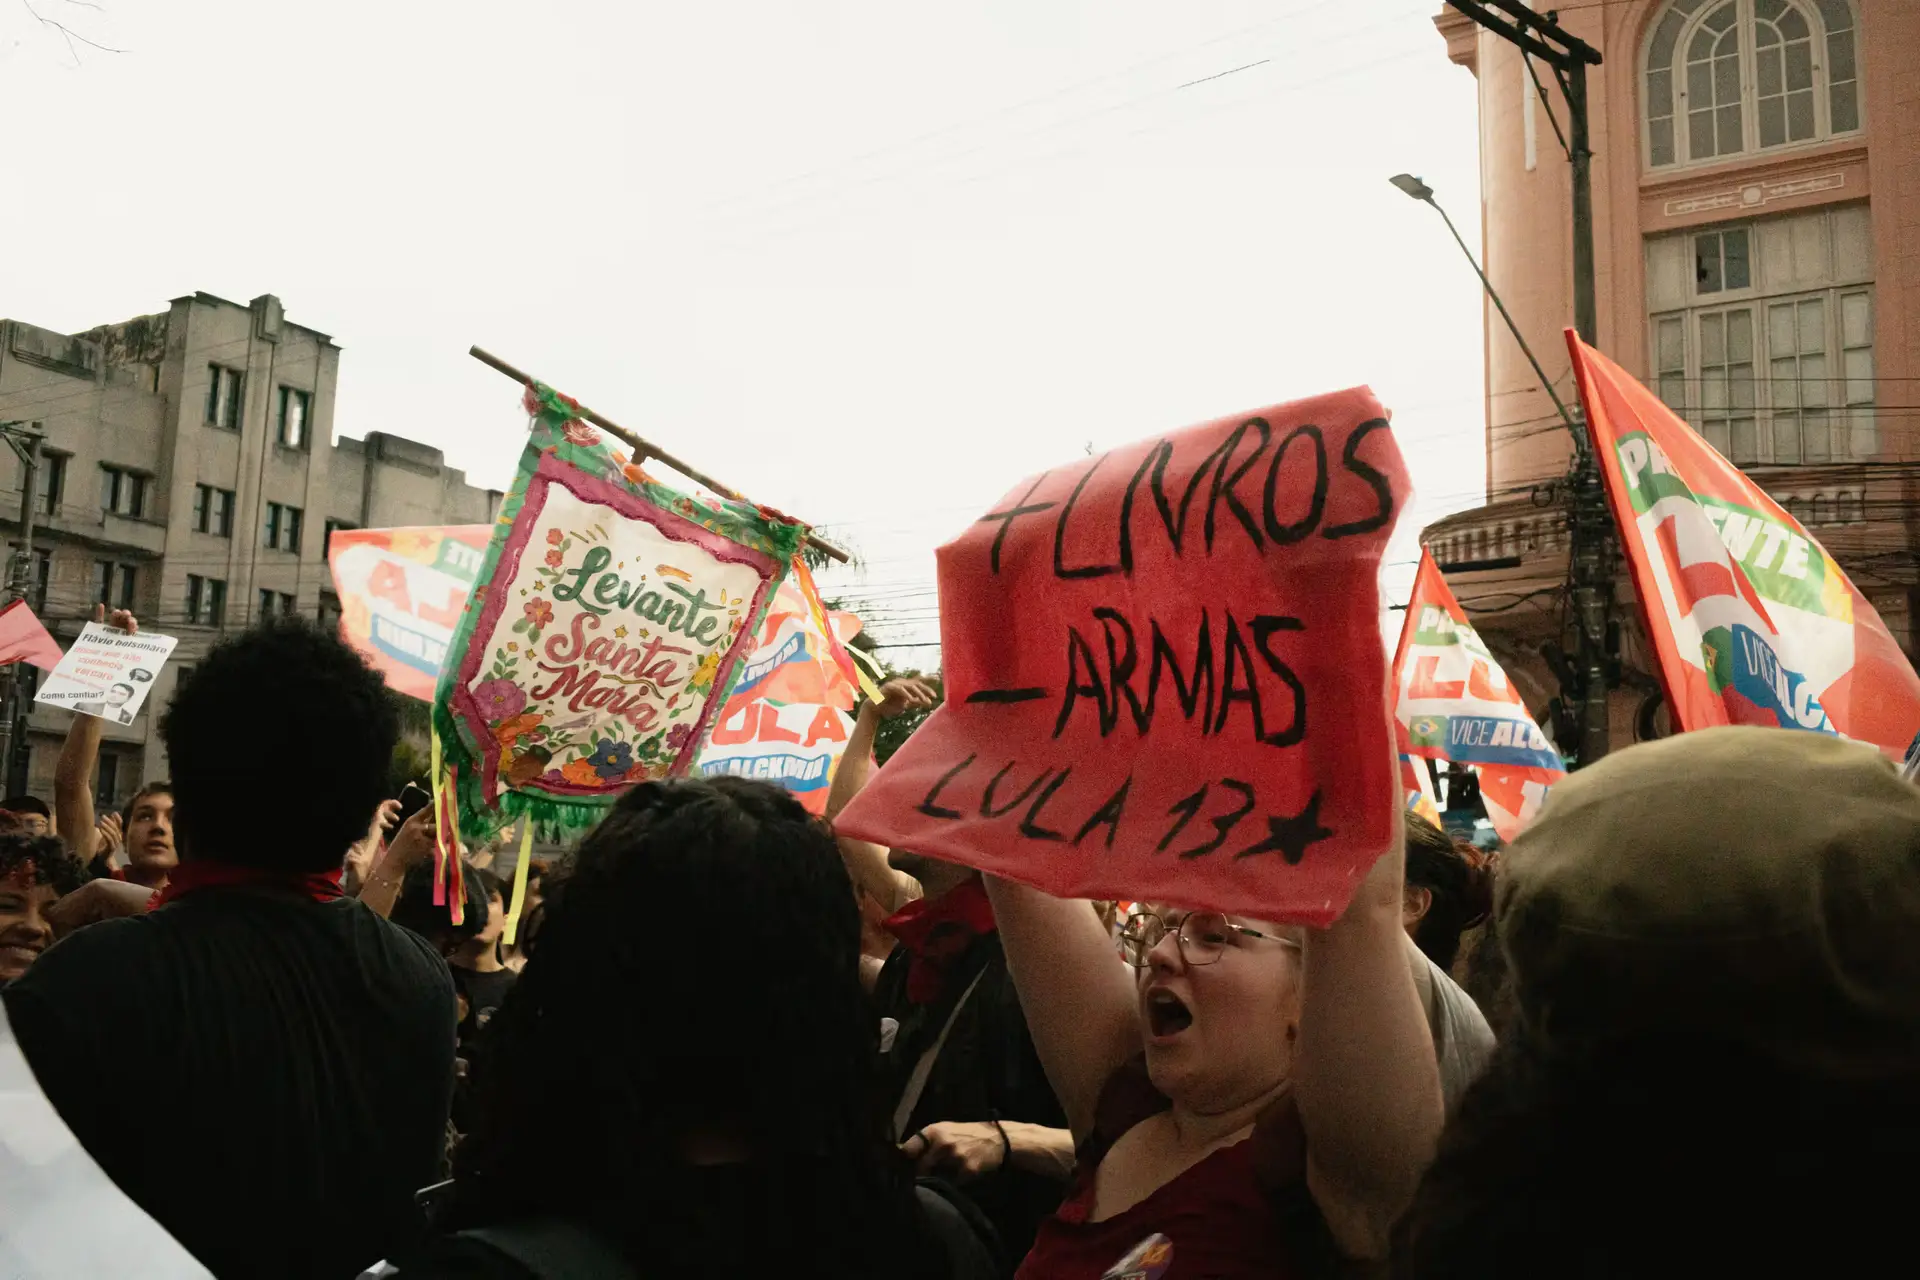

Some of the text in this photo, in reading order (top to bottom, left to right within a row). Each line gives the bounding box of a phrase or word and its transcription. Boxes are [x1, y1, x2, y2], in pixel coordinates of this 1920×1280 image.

[552, 545, 726, 646] Levante
[544, 611, 692, 687] Santa
[530, 660, 664, 733] Maria
[1451, 719, 1492, 747] VICE
[917, 750, 1255, 860] LULA 13
